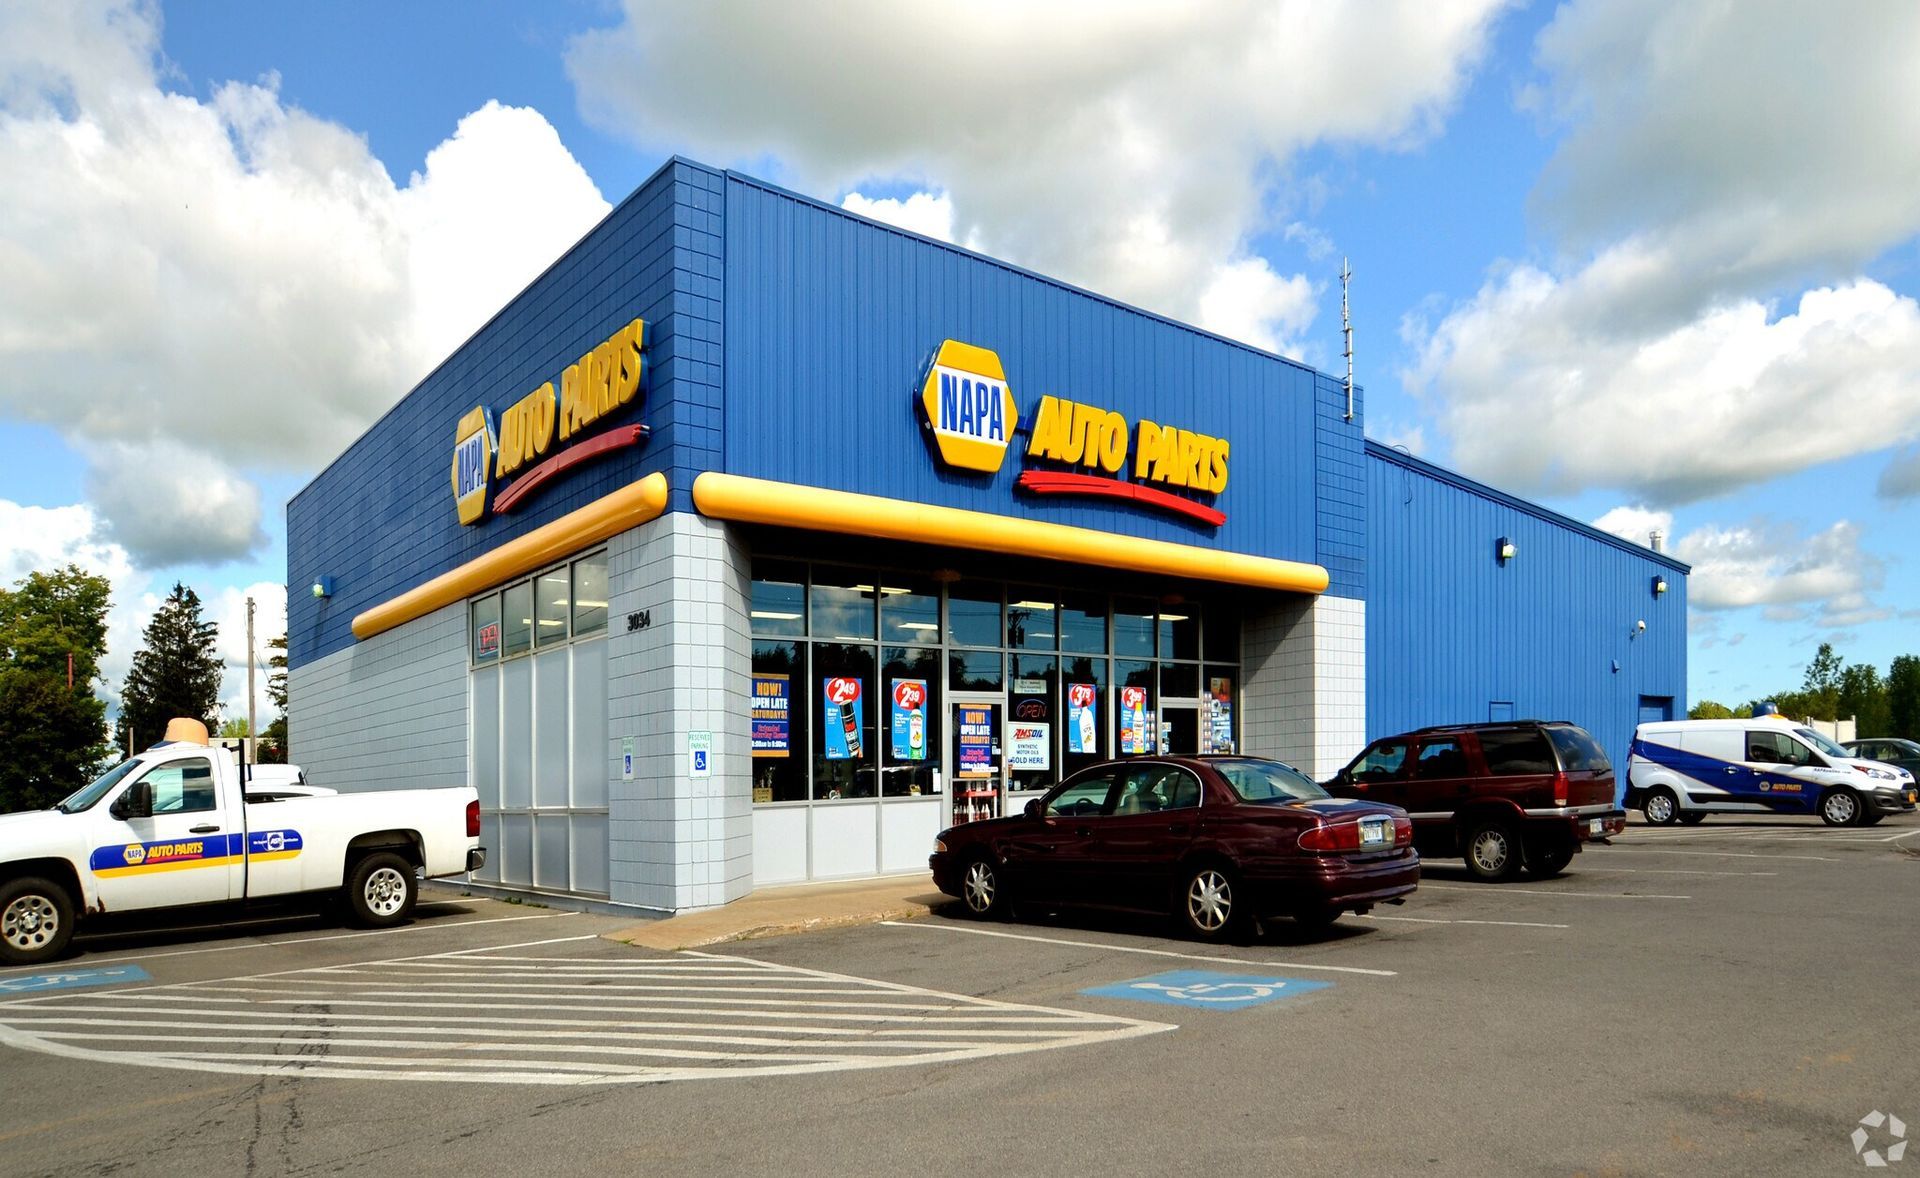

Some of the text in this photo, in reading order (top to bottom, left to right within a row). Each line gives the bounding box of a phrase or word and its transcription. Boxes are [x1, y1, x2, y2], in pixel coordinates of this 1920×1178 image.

[458, 318, 644, 499] NAPA AUTO PARTS
[941, 372, 1230, 494] NAPA AUTO PARTS
[627, 609, 651, 632] 3034
[756, 682, 782, 697] NOW!
[833, 678, 856, 702] 249
[900, 687, 920, 707] 239
[1074, 685, 1092, 706] 379
[752, 696, 788, 710] OPEN LATE
[1127, 688, 1143, 708] 399
[965, 711, 986, 724] NOW!
[1017, 704, 1047, 718] OPEN
[689, 733, 710, 741] RESERVED
[961, 725, 990, 736] OPEN LATE
[1013, 728, 1044, 740] AMSOIL
[1772, 783, 1786, 791] AUTO
[1786, 783, 1802, 791] PARTS
[127, 841, 204, 859] NAPA AUTO PARTS
